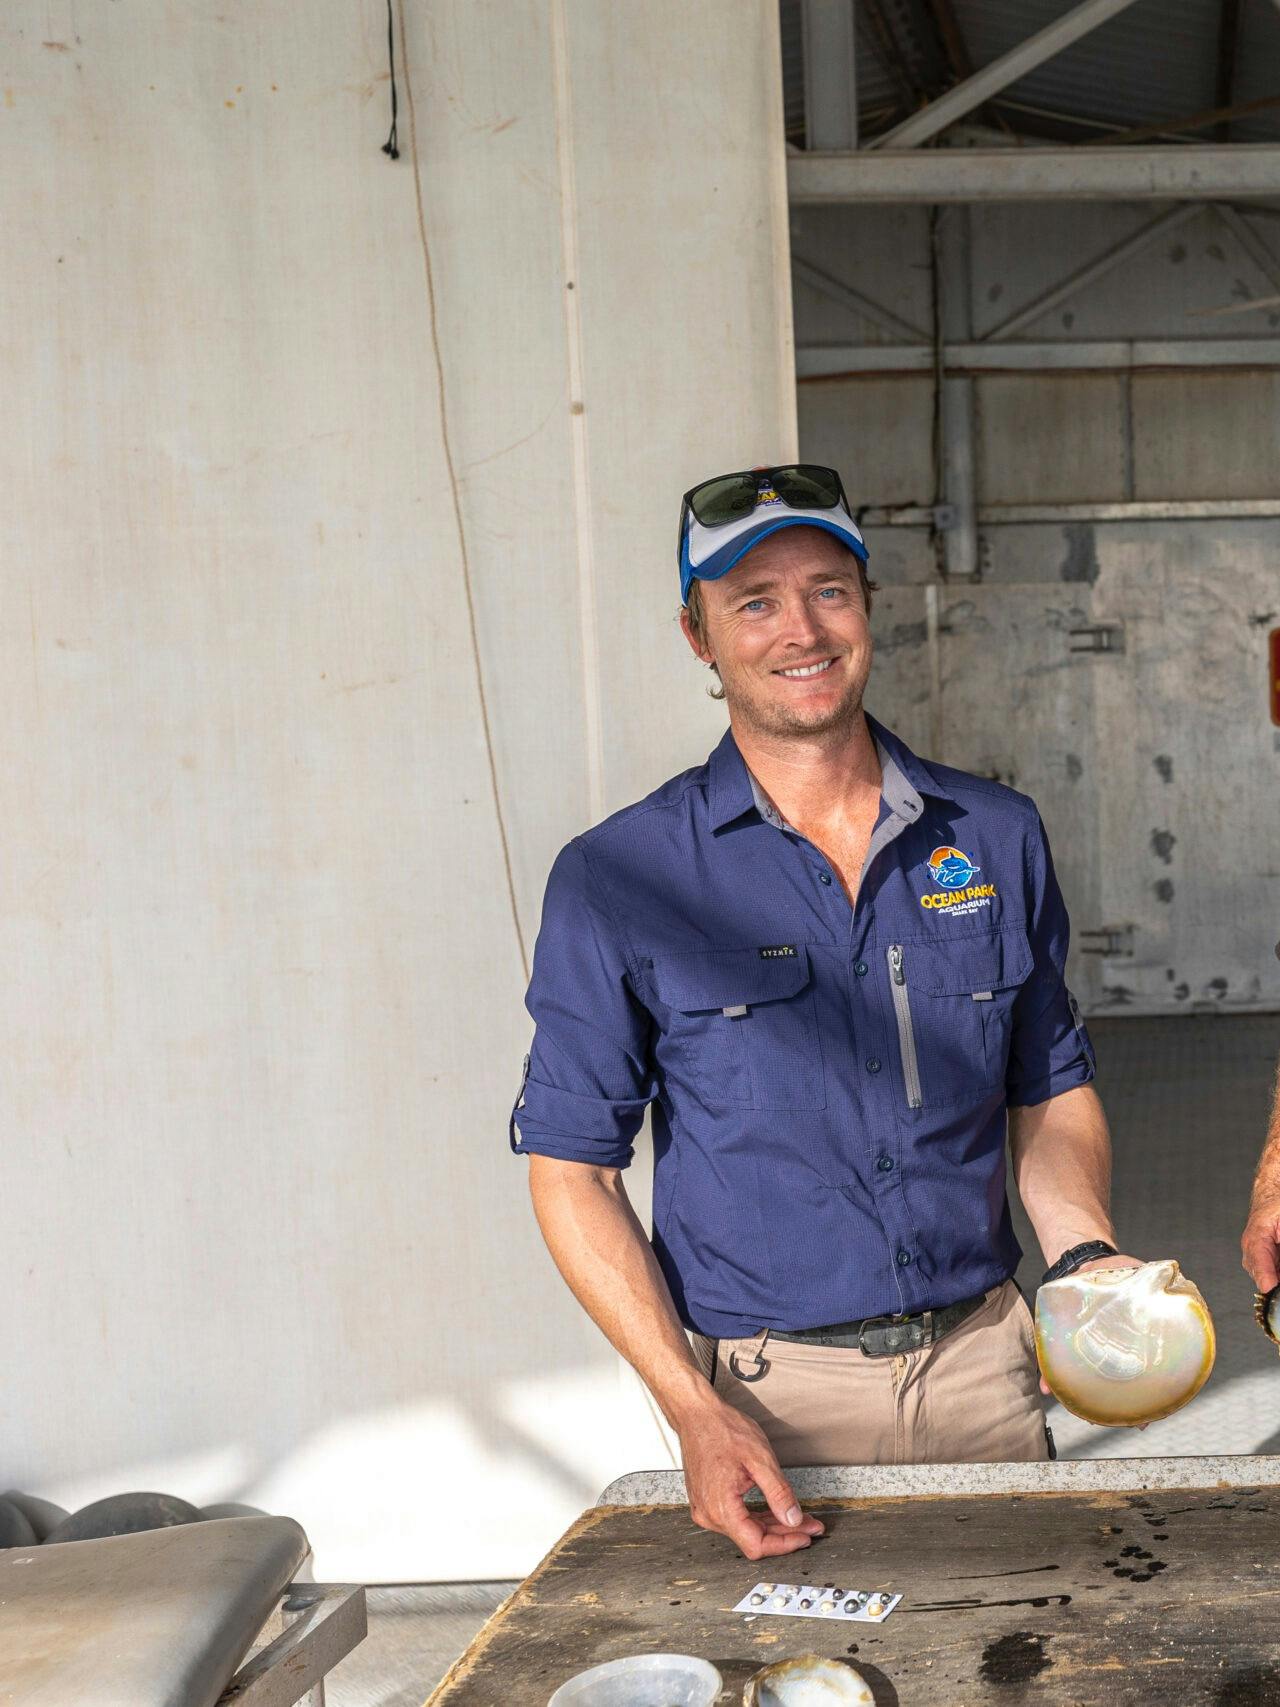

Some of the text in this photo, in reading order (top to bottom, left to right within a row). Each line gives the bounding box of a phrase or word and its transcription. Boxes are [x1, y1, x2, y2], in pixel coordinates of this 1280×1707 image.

[920, 884, 997, 909] OCEAN PARK
[938, 898, 991, 914] AQUARIUM
